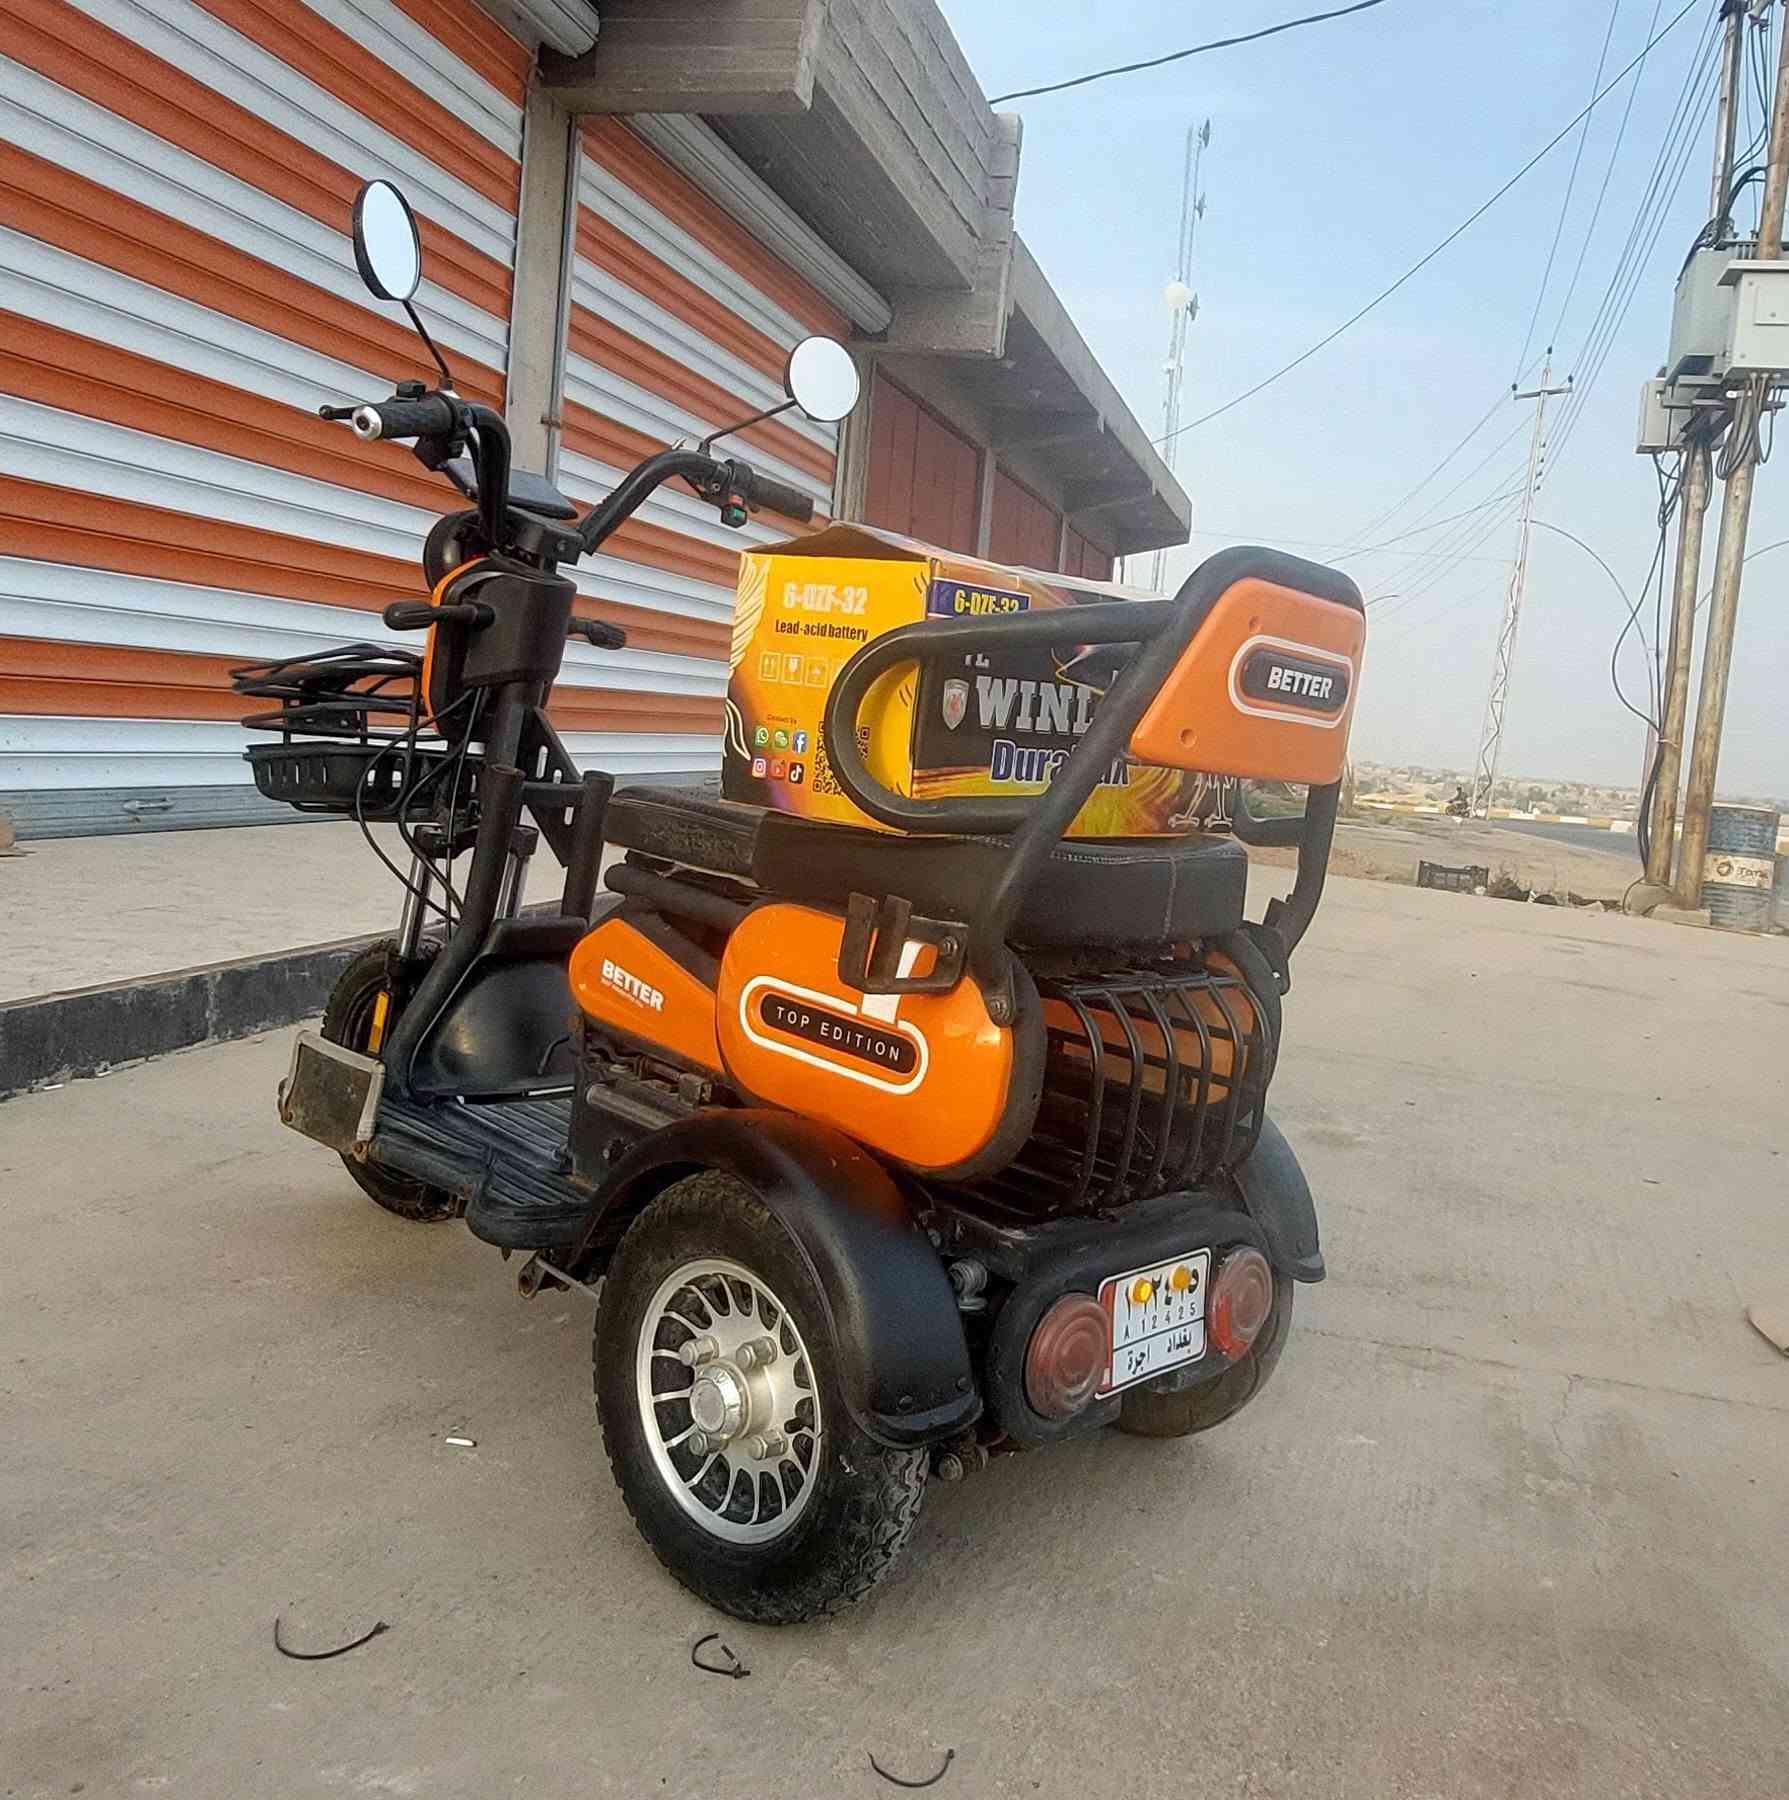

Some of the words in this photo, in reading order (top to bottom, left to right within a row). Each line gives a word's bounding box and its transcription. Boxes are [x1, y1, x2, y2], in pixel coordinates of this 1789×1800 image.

[829, 624, 869, 642] battery
[1267, 665, 1333, 699] BETTER
[601, 958, 665, 1012] BETTER
[775, 1005, 811, 1028] TOP
[819, 1022, 901, 1062] EDITION
[1166, 1327, 1193, 1355] بغداد
